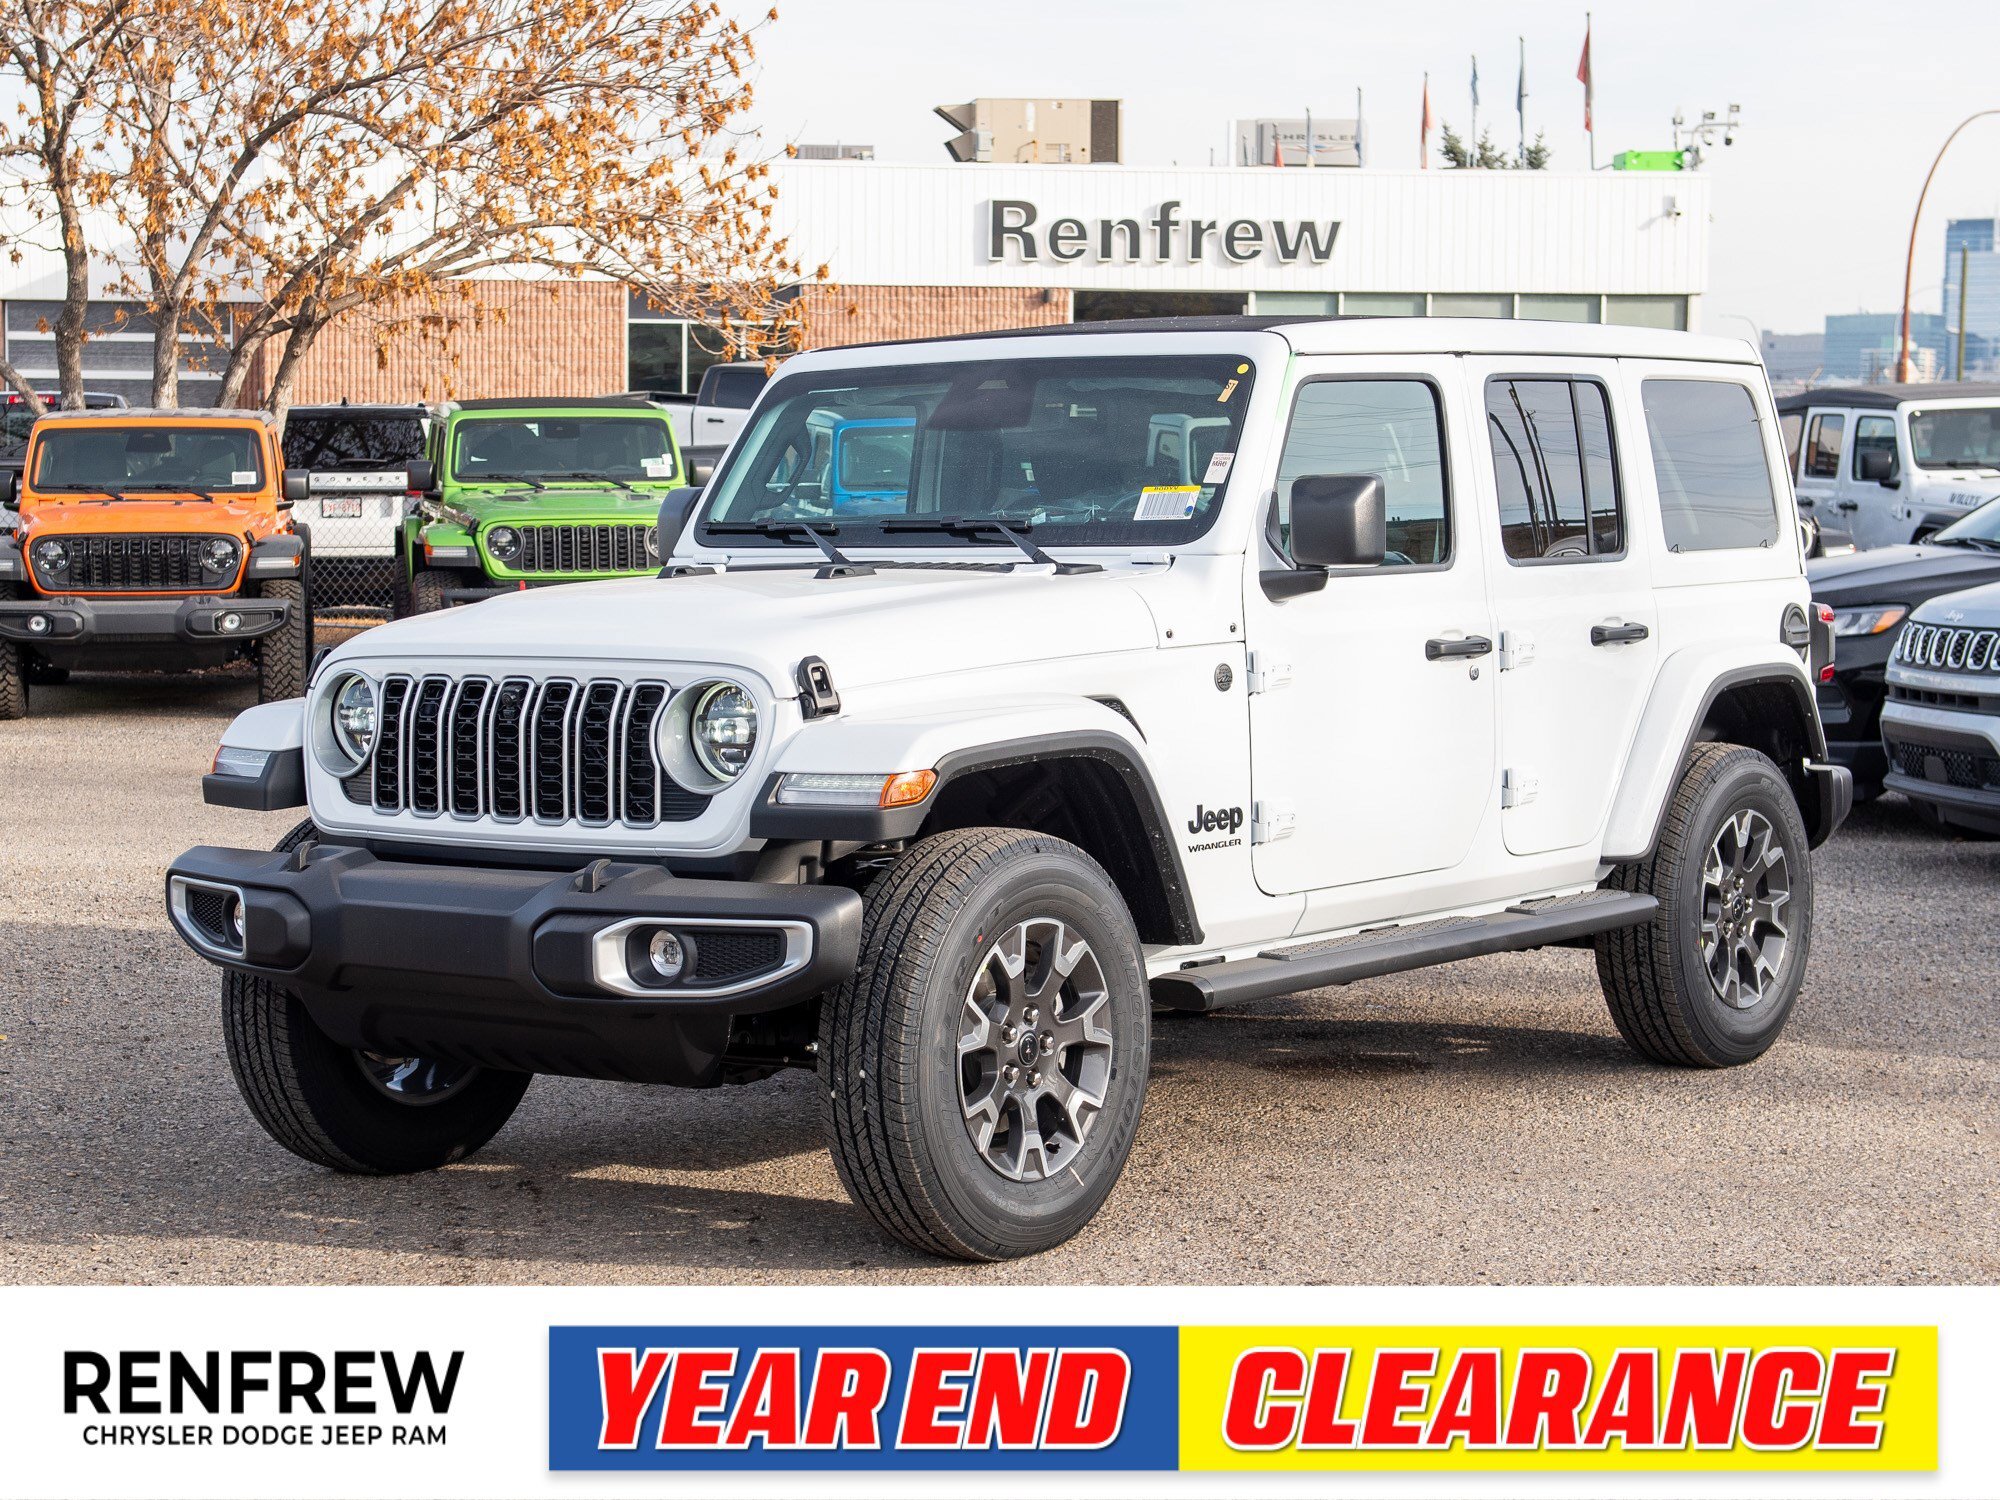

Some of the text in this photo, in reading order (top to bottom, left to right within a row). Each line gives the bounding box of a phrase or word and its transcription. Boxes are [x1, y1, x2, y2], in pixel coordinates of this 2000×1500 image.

[989, 199, 1342, 262] Renfrew
[1187, 804, 1244, 835] Jeep
[1187, 838, 1242, 853] WRANGLER
